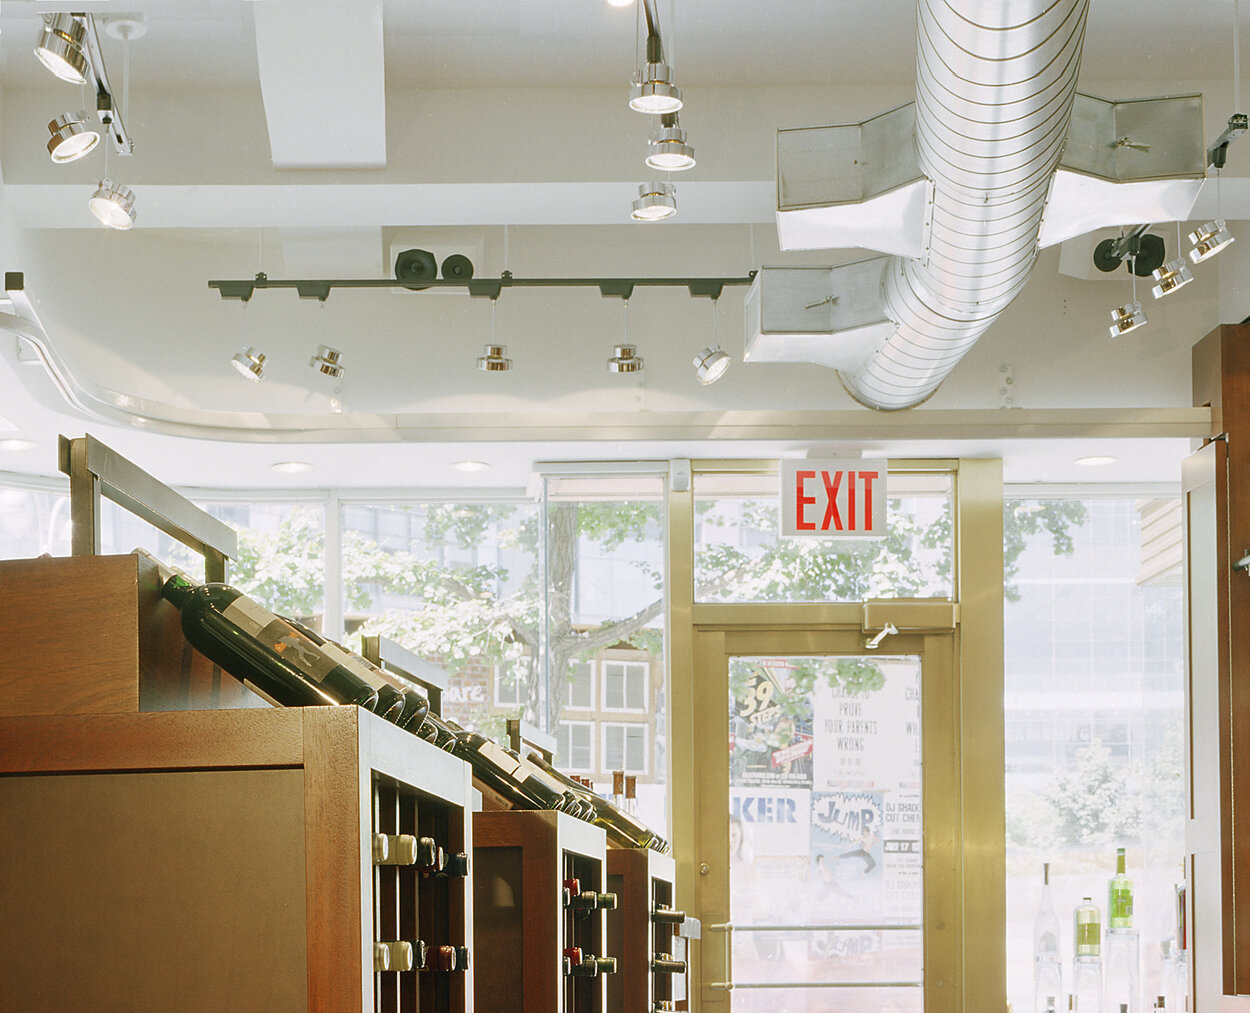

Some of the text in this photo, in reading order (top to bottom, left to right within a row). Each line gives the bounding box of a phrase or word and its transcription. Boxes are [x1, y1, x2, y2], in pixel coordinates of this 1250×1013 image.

[796, 470, 879, 531] EXIT
[739, 681, 774, 717] 39
[749, 703, 782, 726] STEPS
[839, 703, 862, 717] PROVE
[824, 719, 877, 735] YOUR PARENTS
[836, 737, 864, 751] WRONG
[733, 797, 797, 823] KER
[886, 803, 896, 812] DJ
[817, 801, 874, 836] JUMP
[885, 813, 899, 823] CUT
